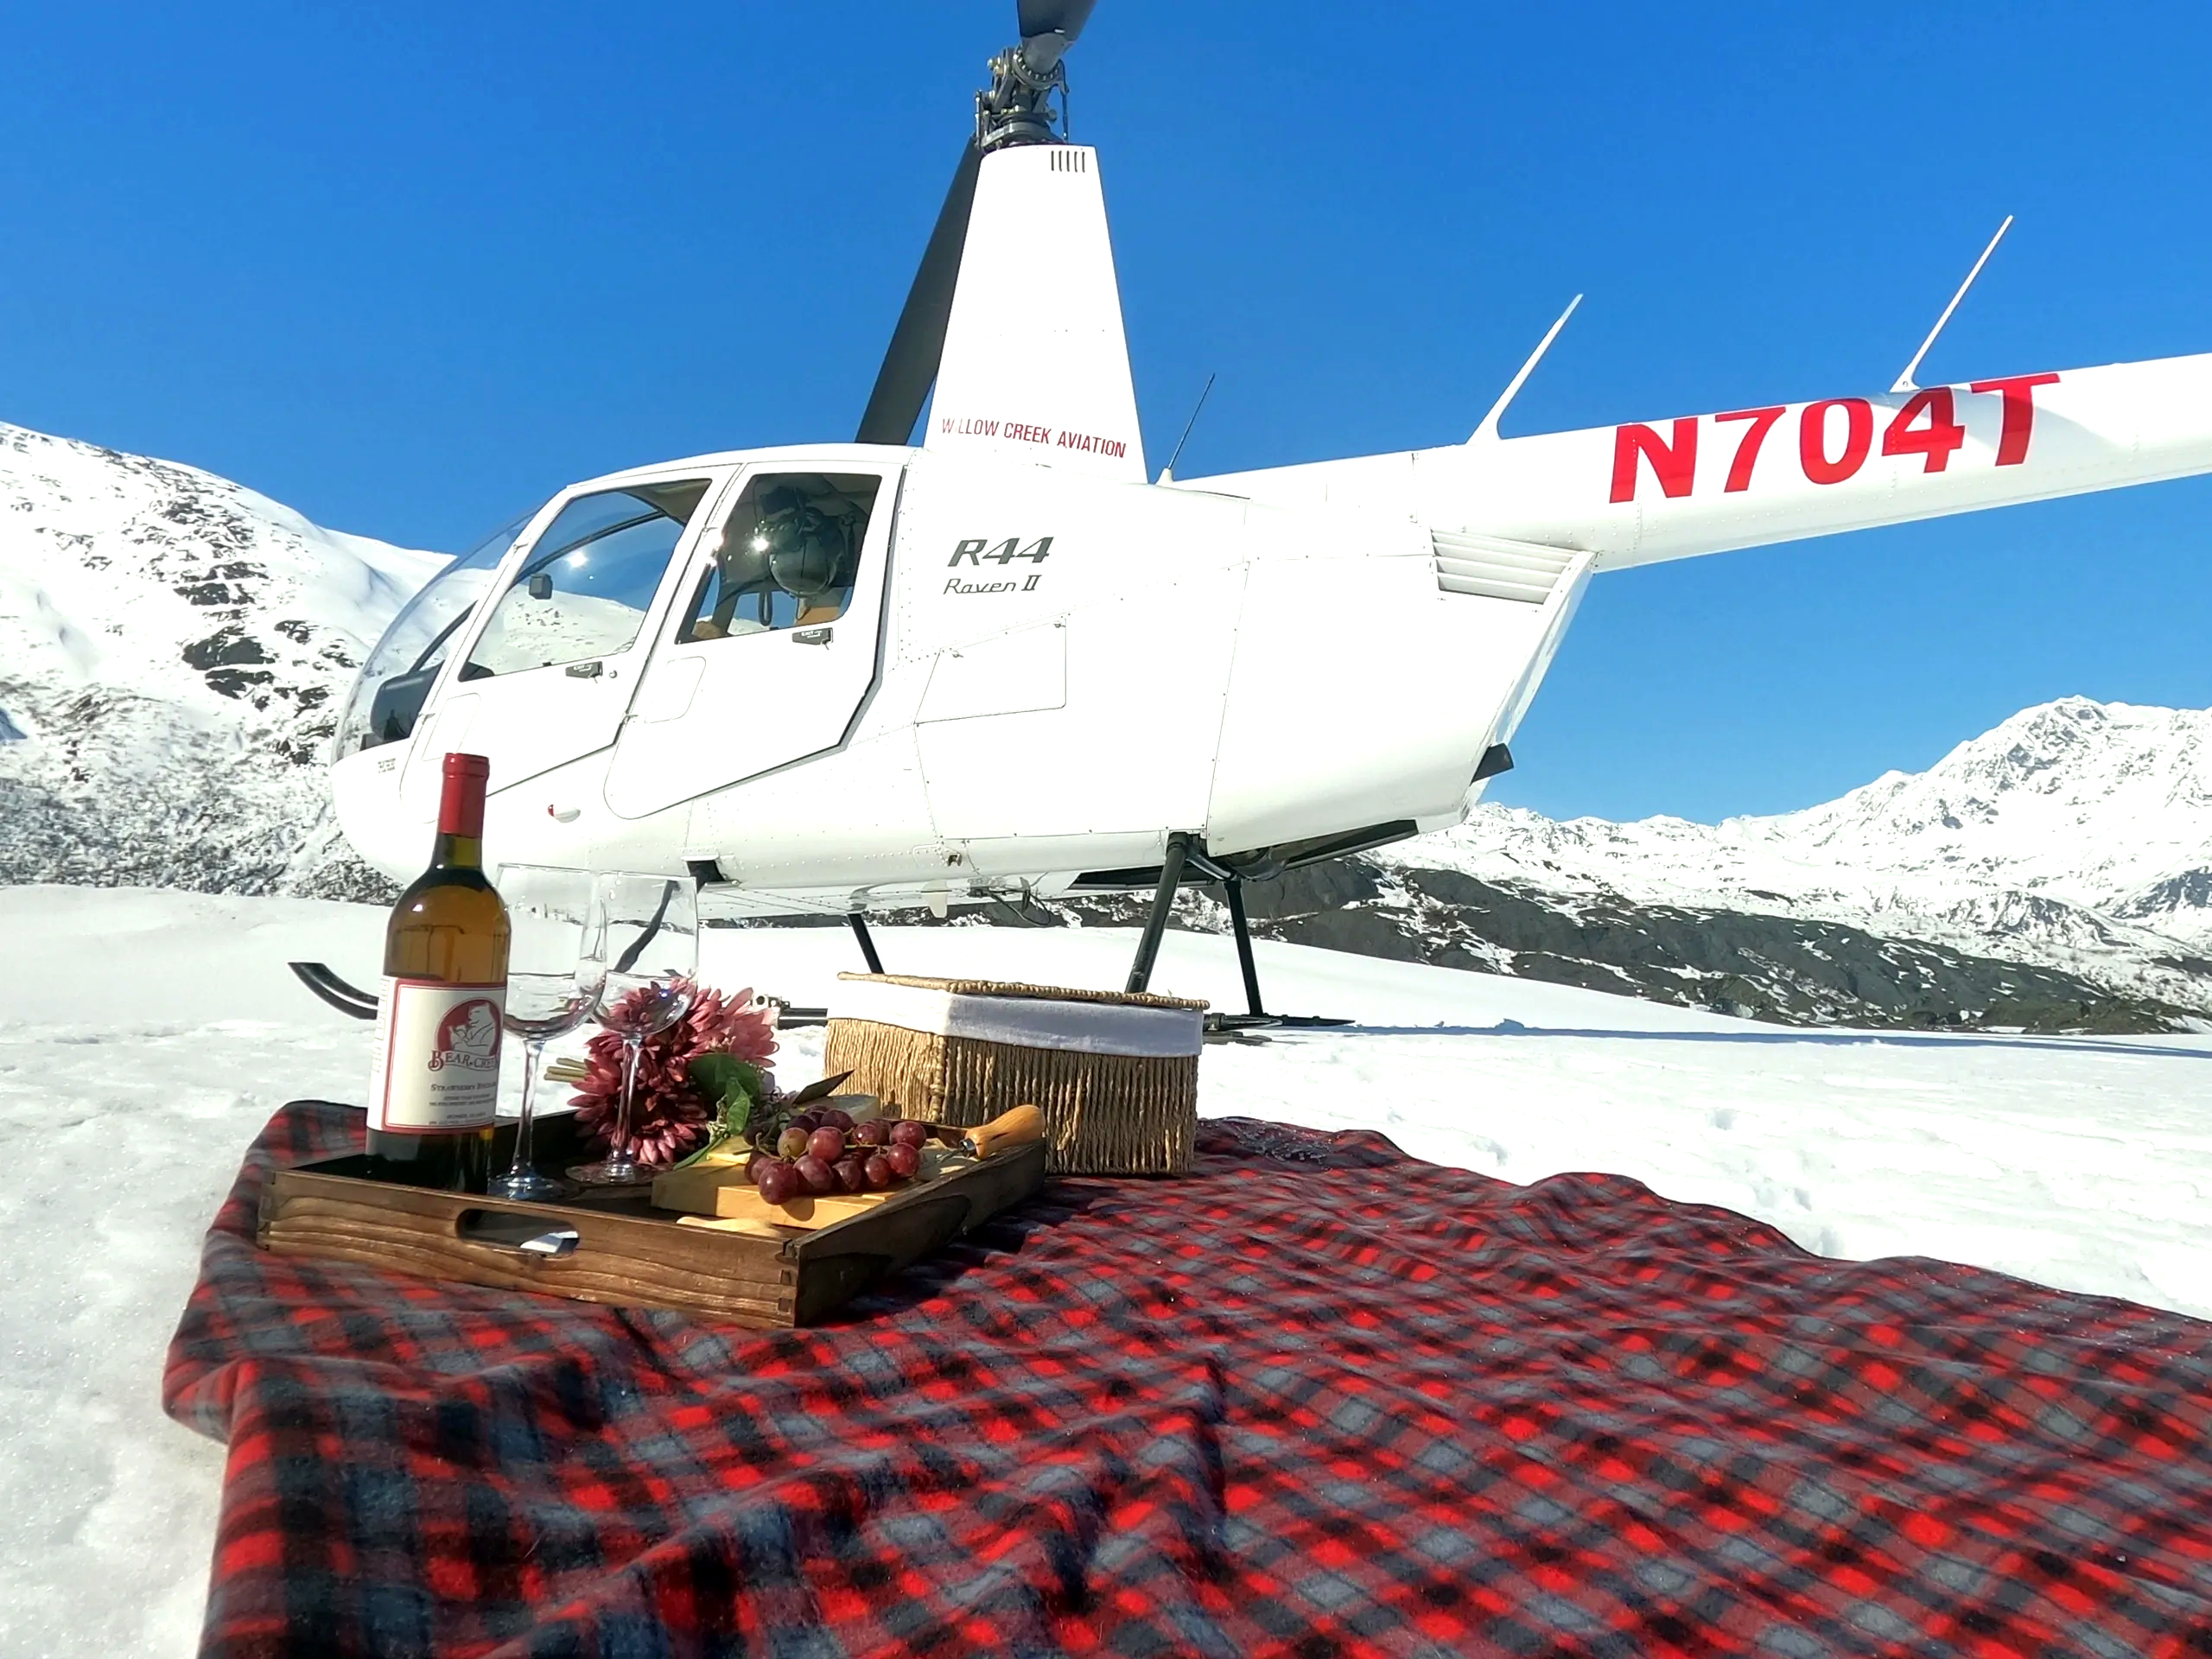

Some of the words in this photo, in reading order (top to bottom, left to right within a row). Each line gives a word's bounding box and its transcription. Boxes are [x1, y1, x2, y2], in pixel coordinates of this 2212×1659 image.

[943, 418, 1000, 436] WLLOW
[1004, 423, 1052, 444] CREEK
[1057, 431, 1126, 458] AVIATION
[1609, 372, 2061, 503] N704T
[947, 537, 1054, 567] R44
[944, 578, 1016, 594] Raven
[1021, 575, 1042, 591] II
